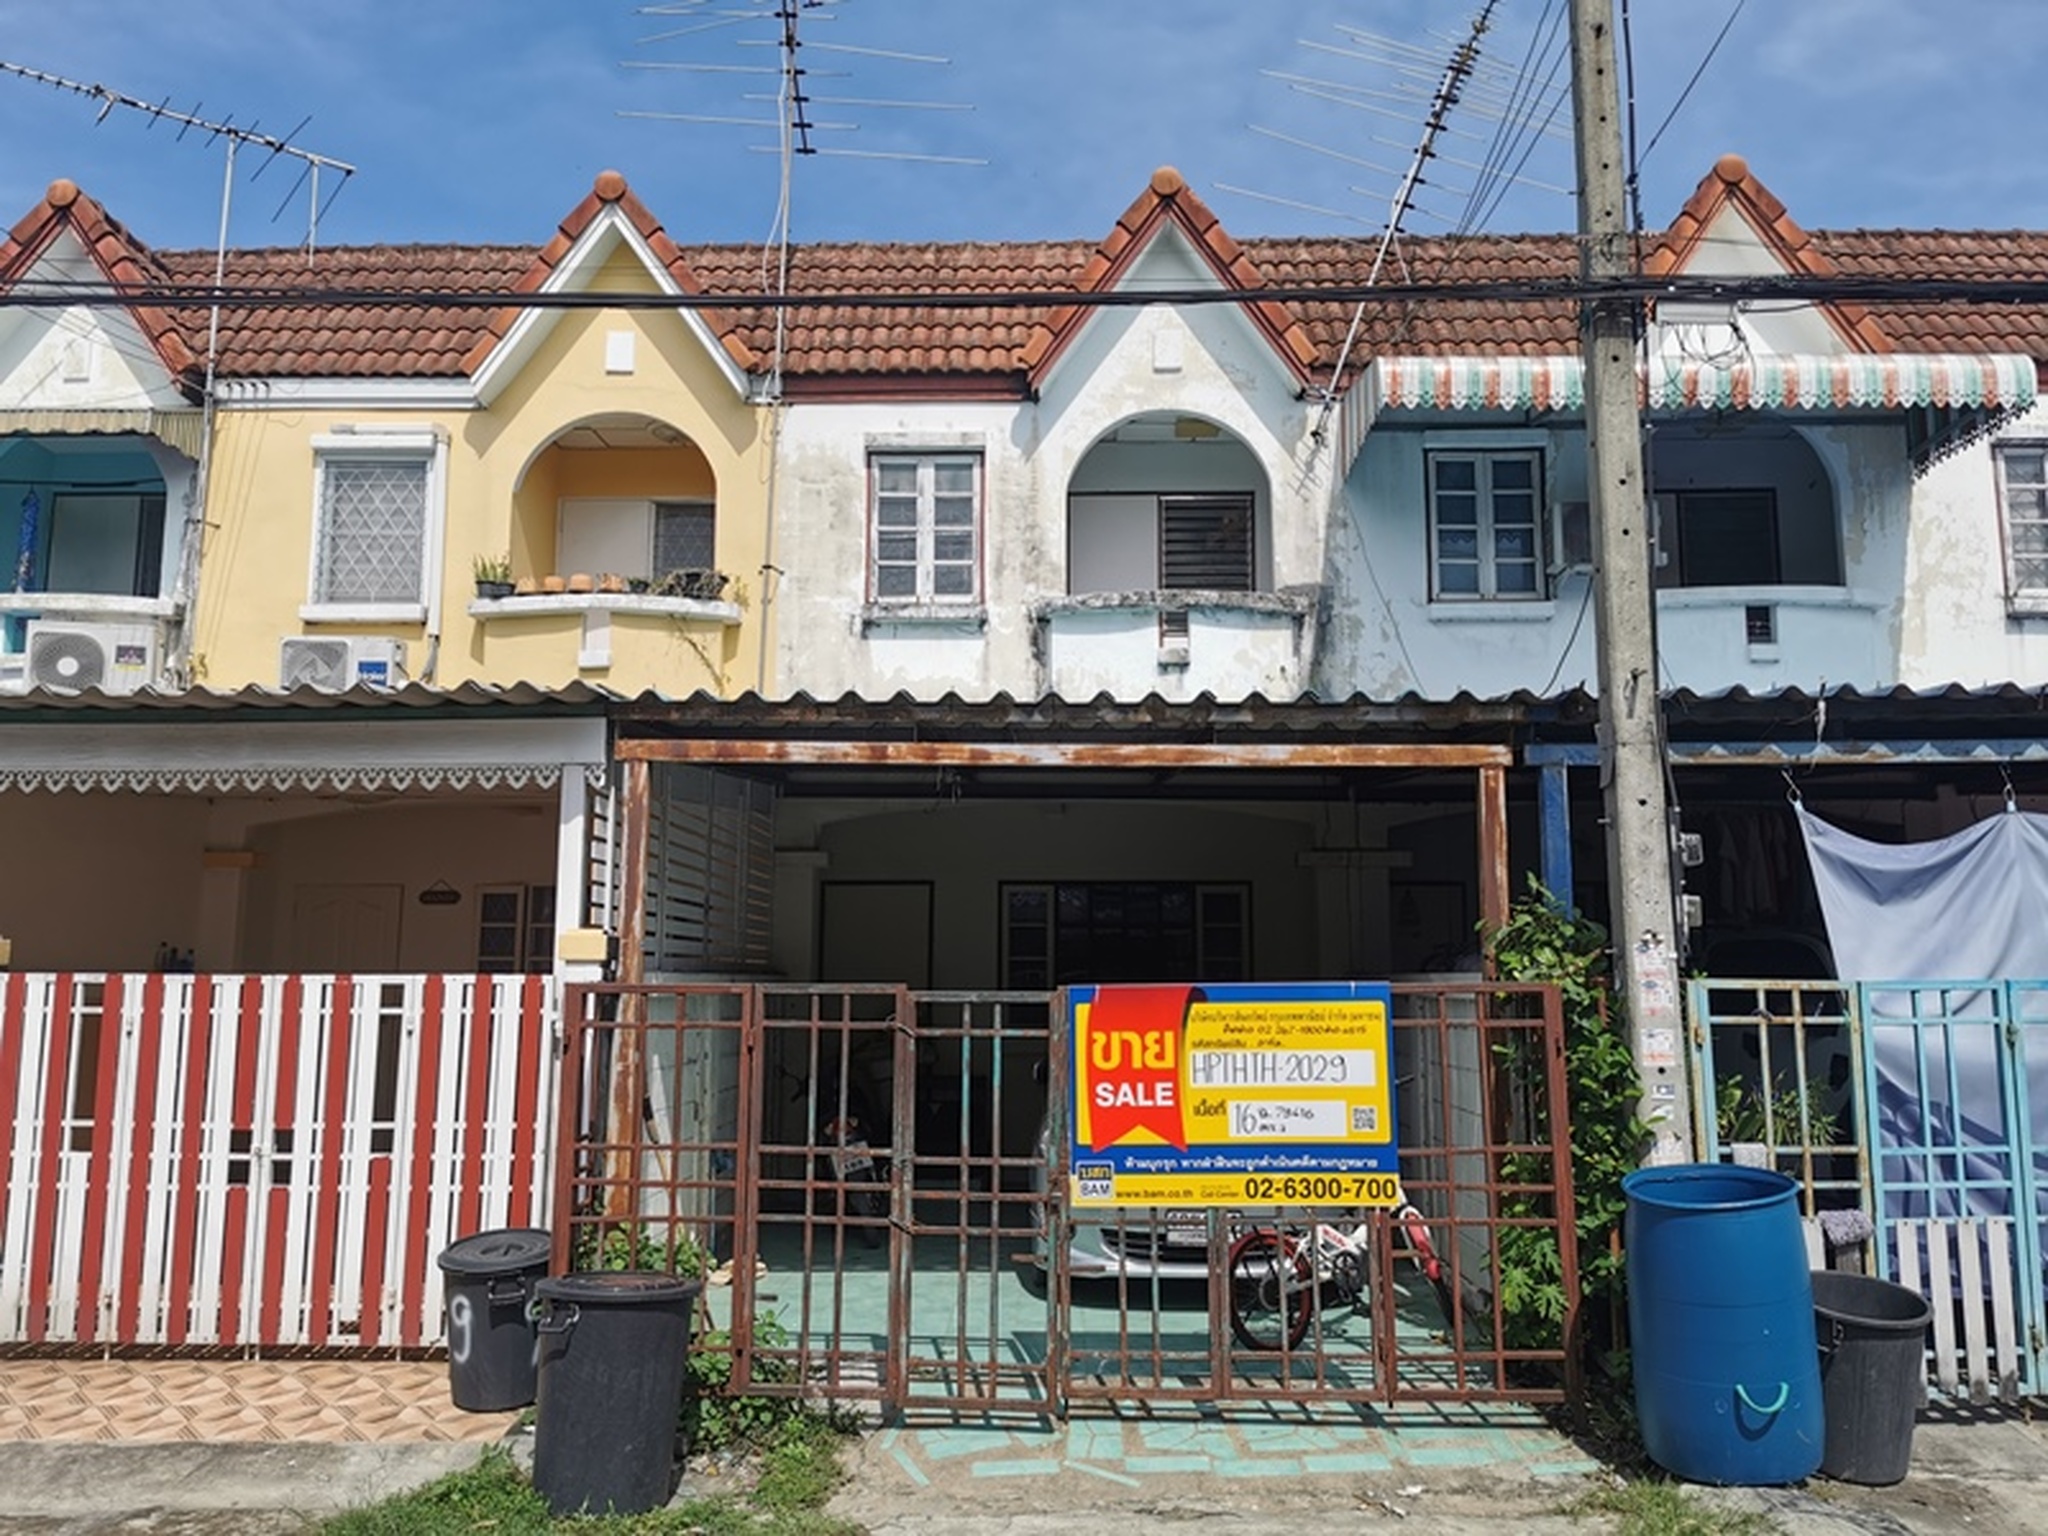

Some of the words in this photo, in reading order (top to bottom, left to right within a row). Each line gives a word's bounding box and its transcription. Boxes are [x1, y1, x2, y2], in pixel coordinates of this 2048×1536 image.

[1092, 1031, 1175, 1070] ขาย
[1192, 1051, 1347, 1084] HPTHTH-2029
[1095, 1082, 1174, 1107] SALE
[1235, 1103, 1258, 1135] 16
[1081, 1181, 1111, 1196] BAM
[1245, 1178, 1397, 1199] 02-6300-700
[451, 1294, 472, 1363] 9
